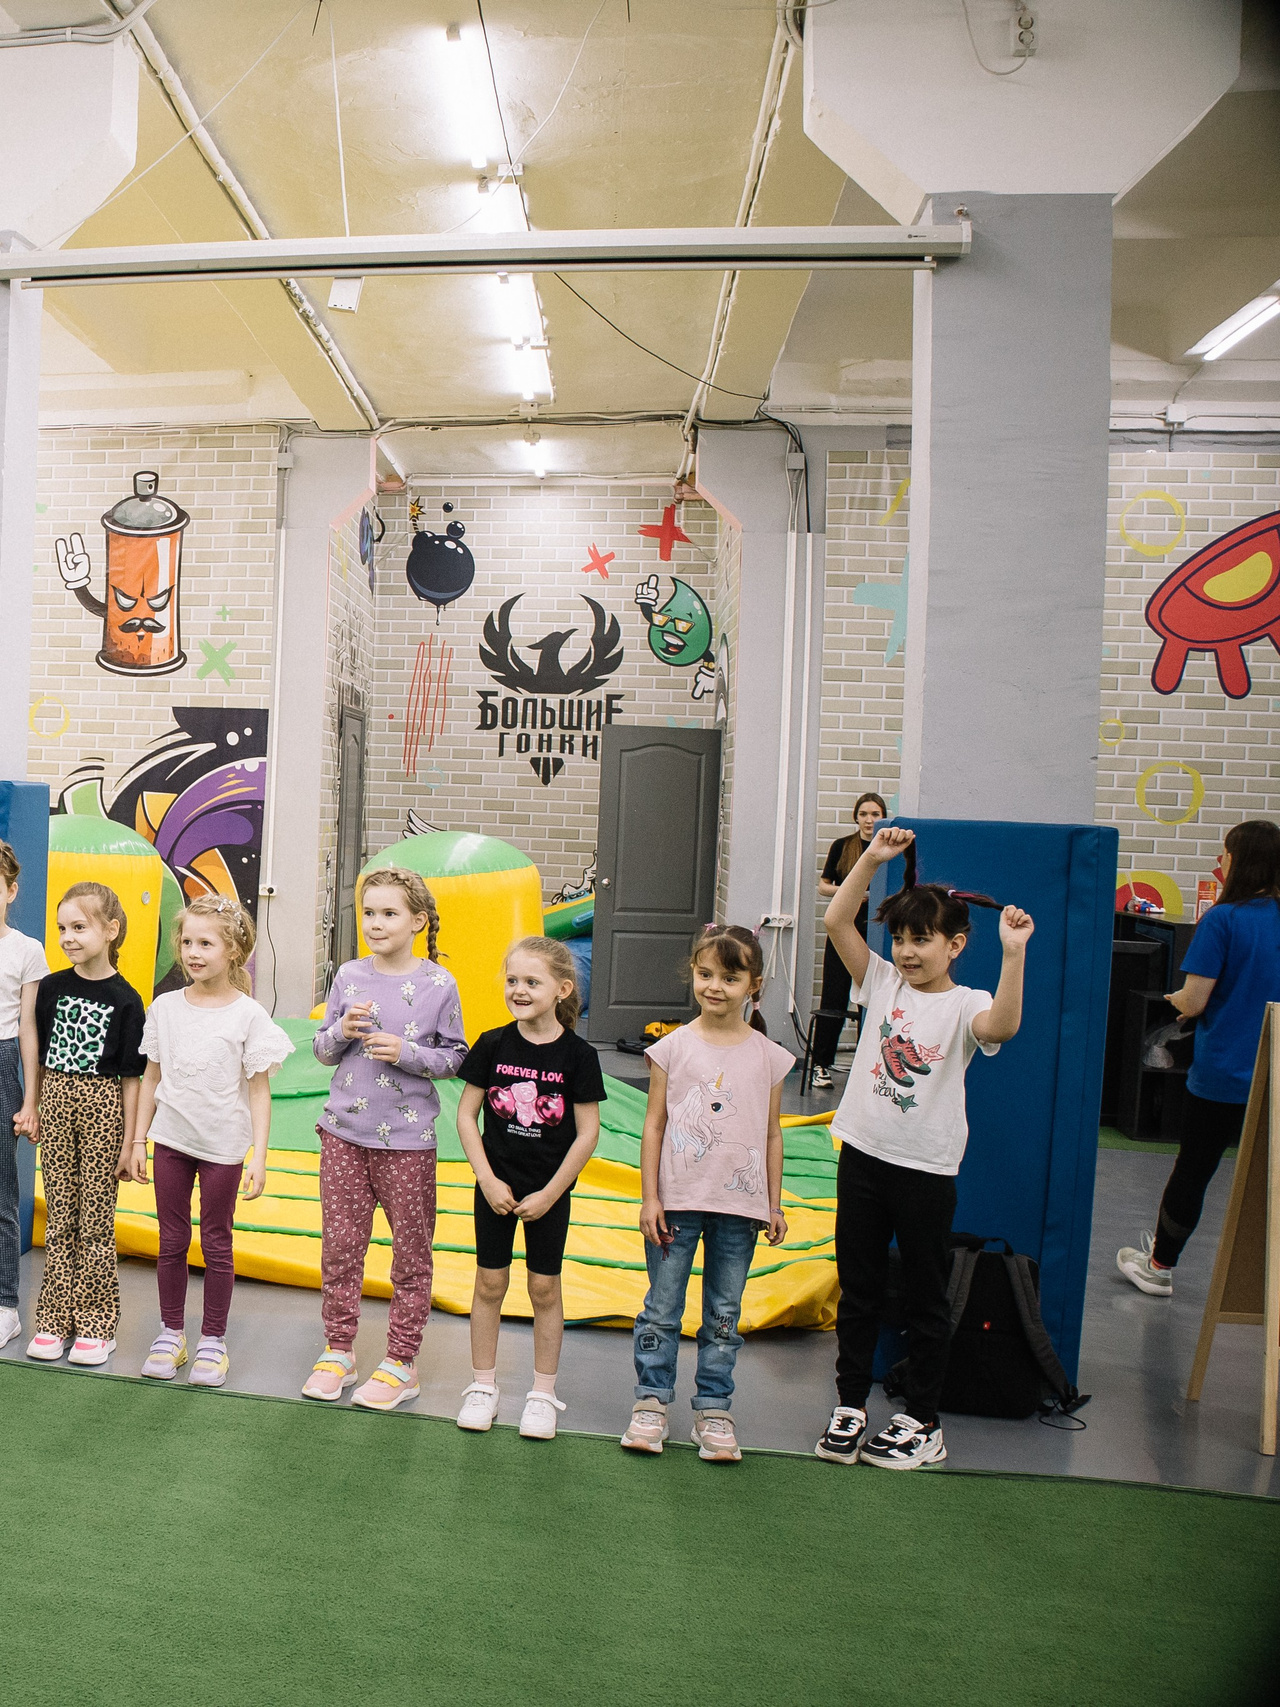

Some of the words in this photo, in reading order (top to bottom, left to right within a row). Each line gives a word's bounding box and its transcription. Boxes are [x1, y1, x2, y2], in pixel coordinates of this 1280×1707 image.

[475, 690, 625, 731] БОЛЬШИЕ
[498, 732, 598, 761] ГОНКИ
[496, 1064, 538, 1080] FOREVER
